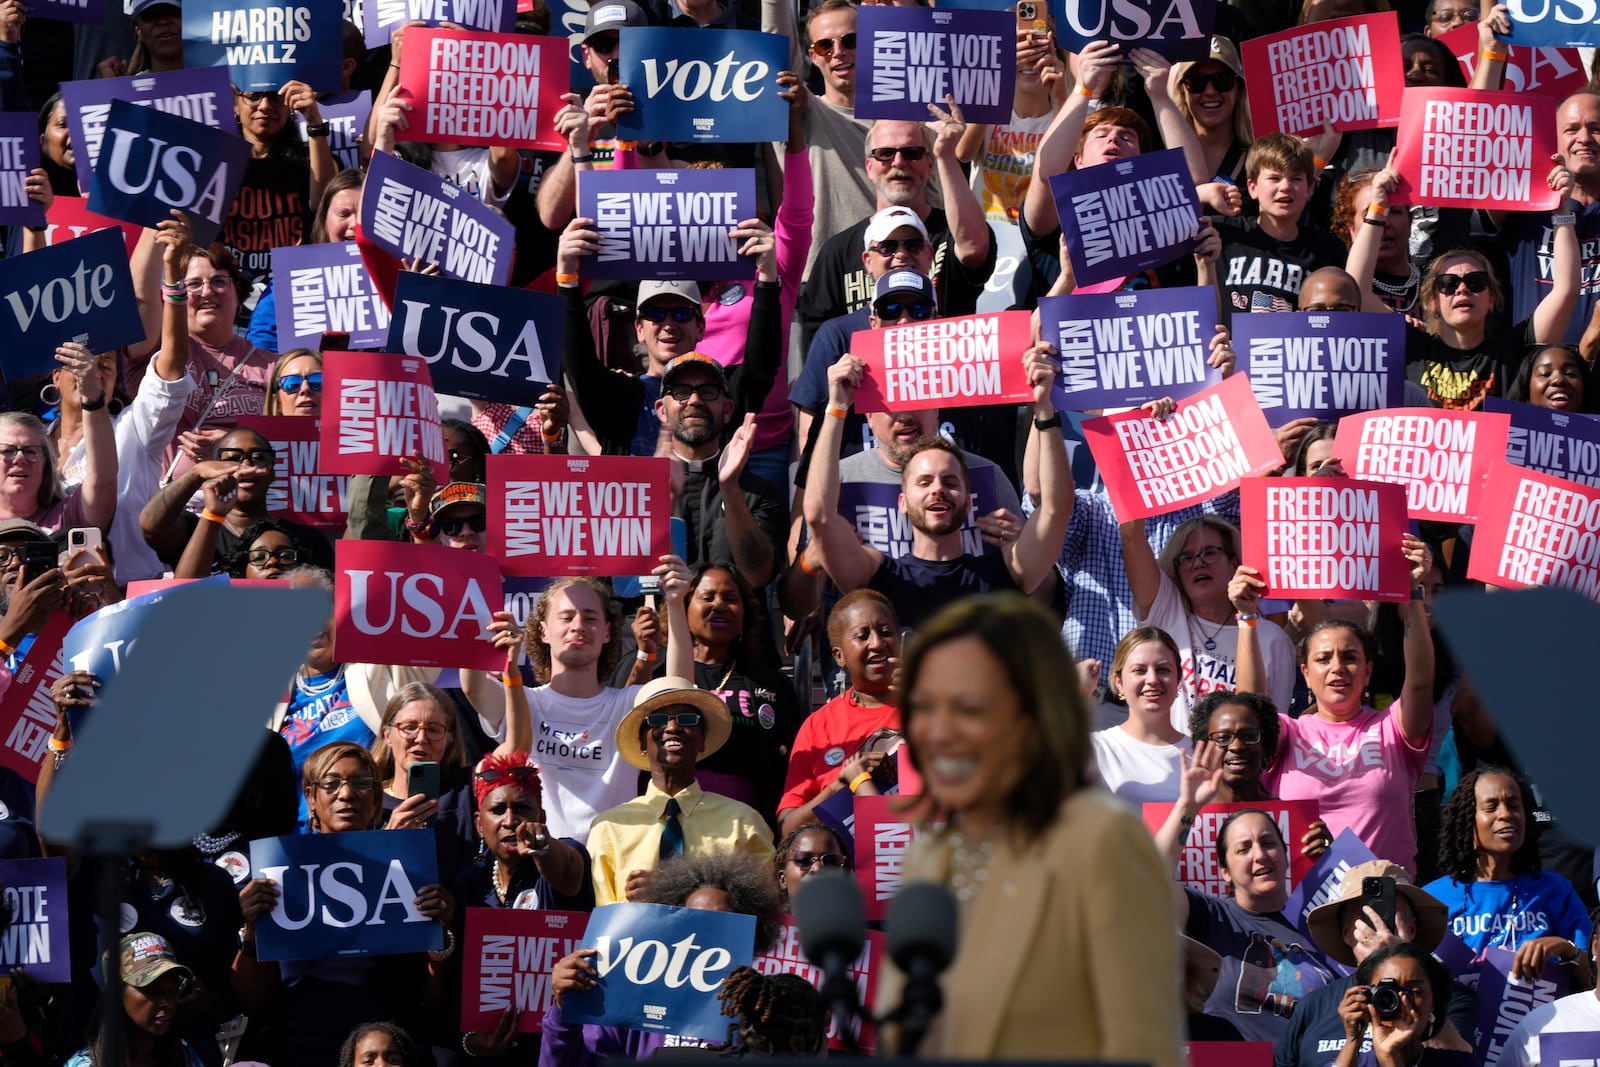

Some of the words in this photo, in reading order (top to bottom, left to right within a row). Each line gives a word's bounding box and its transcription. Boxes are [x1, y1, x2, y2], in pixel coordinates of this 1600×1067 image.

[211, 6, 311, 45] HARRIS
[1065, 0, 1205, 40] USA
[226, 44, 296, 65] WALZ
[430, 38, 540, 76] FREEDOM
[872, 31, 907, 102] WHEN
[908, 32, 945, 67] WE
[950, 35, 1001, 69] VOTE
[1268, 24, 1370, 75] FREEDOM
[428, 71, 539, 108] FREEDOM
[641, 50, 769, 102] vote
[907, 66, 949, 104] WE
[950, 69, 1000, 107] WIN
[1272, 56, 1374, 105] FREEDOM
[426, 106, 538, 140] FREEDOM
[1276, 88, 1378, 133] FREEDOM
[1424, 100, 1532, 137] FREEDOM
[1422, 133, 1532, 169] FREEDOM
[108, 127, 228, 225] USA
[1421, 166, 1530, 201] FREEDOM
[373, 177, 414, 246] WHEN
[631, 193, 672, 226] WE
[675, 192, 738, 225] VOTE
[1101, 183, 1140, 220] WE
[1138, 173, 1190, 211] VOTE
[224, 216, 303, 251] ASIANS
[411, 190, 450, 232] WE
[451, 208, 500, 255] VOTE
[598, 193, 631, 262] WHEN
[1072, 191, 1113, 267] WHEN
[1109, 217, 1155, 258] WE
[1149, 206, 1199, 249] WIN
[403, 220, 447, 267] WE
[445, 237, 494, 285] WIN
[632, 226, 677, 263] WE
[679, 226, 738, 262] WIN
[3, 262, 115, 333] vote
[324, 264, 365, 298] WE
[290, 268, 327, 337] WHEN
[326, 296, 371, 332] WE
[401, 300, 553, 384] USA
[884, 317, 999, 341] FREEDOM
[1095, 316, 1138, 352] WE
[1138, 311, 1202, 347] VOTE
[884, 335, 999, 368] FREEDOM
[1059, 320, 1097, 392] WHEN
[1096, 350, 1145, 390] WE
[1145, 345, 1205, 386] WIN
[1284, 338, 1324, 371] WE
[1328, 338, 1388, 371] VOTE
[885, 362, 1001, 402] FREEDOM
[1250, 338, 1283, 409] WHEN
[1284, 372, 1328, 409] WE
[1331, 373, 1388, 410] WIN
[338, 379, 376, 454] WHEN
[377, 380, 416, 417] WE
[376, 417, 420, 456] WE
[1114, 393, 1228, 452] FREEDOM
[1360, 416, 1477, 452] FREEDOM
[1125, 419, 1240, 480] FREEDOM
[1356, 444, 1472, 485] FREEDOM
[1529, 429, 1564, 469] WE
[290, 476, 334, 512] WE
[440, 483, 478, 500] HARRIS
[1136, 445, 1252, 509] FREEDOM
[506, 482, 540, 556] WHEN
[542, 482, 585, 517] WE
[587, 482, 651, 517] VOTE
[1267, 486, 1380, 522] FREEDOM
[542, 518, 588, 556] WE
[590, 518, 651, 556] WIN
[1267, 521, 1380, 556] FREEDOM
[1268, 556, 1379, 591] FREEDOM
[344, 569, 494, 642] USA
[22, 679, 58, 728] WE
[537, 739, 602, 760] CHOICE
[540, 721, 576, 741] MEN
[874, 822, 911, 901] WHEN
[260, 859, 433, 930] USA
[480, 935, 516, 1013] WHEN
[518, 936, 559, 973] WE
[597, 933, 731, 992] vote
